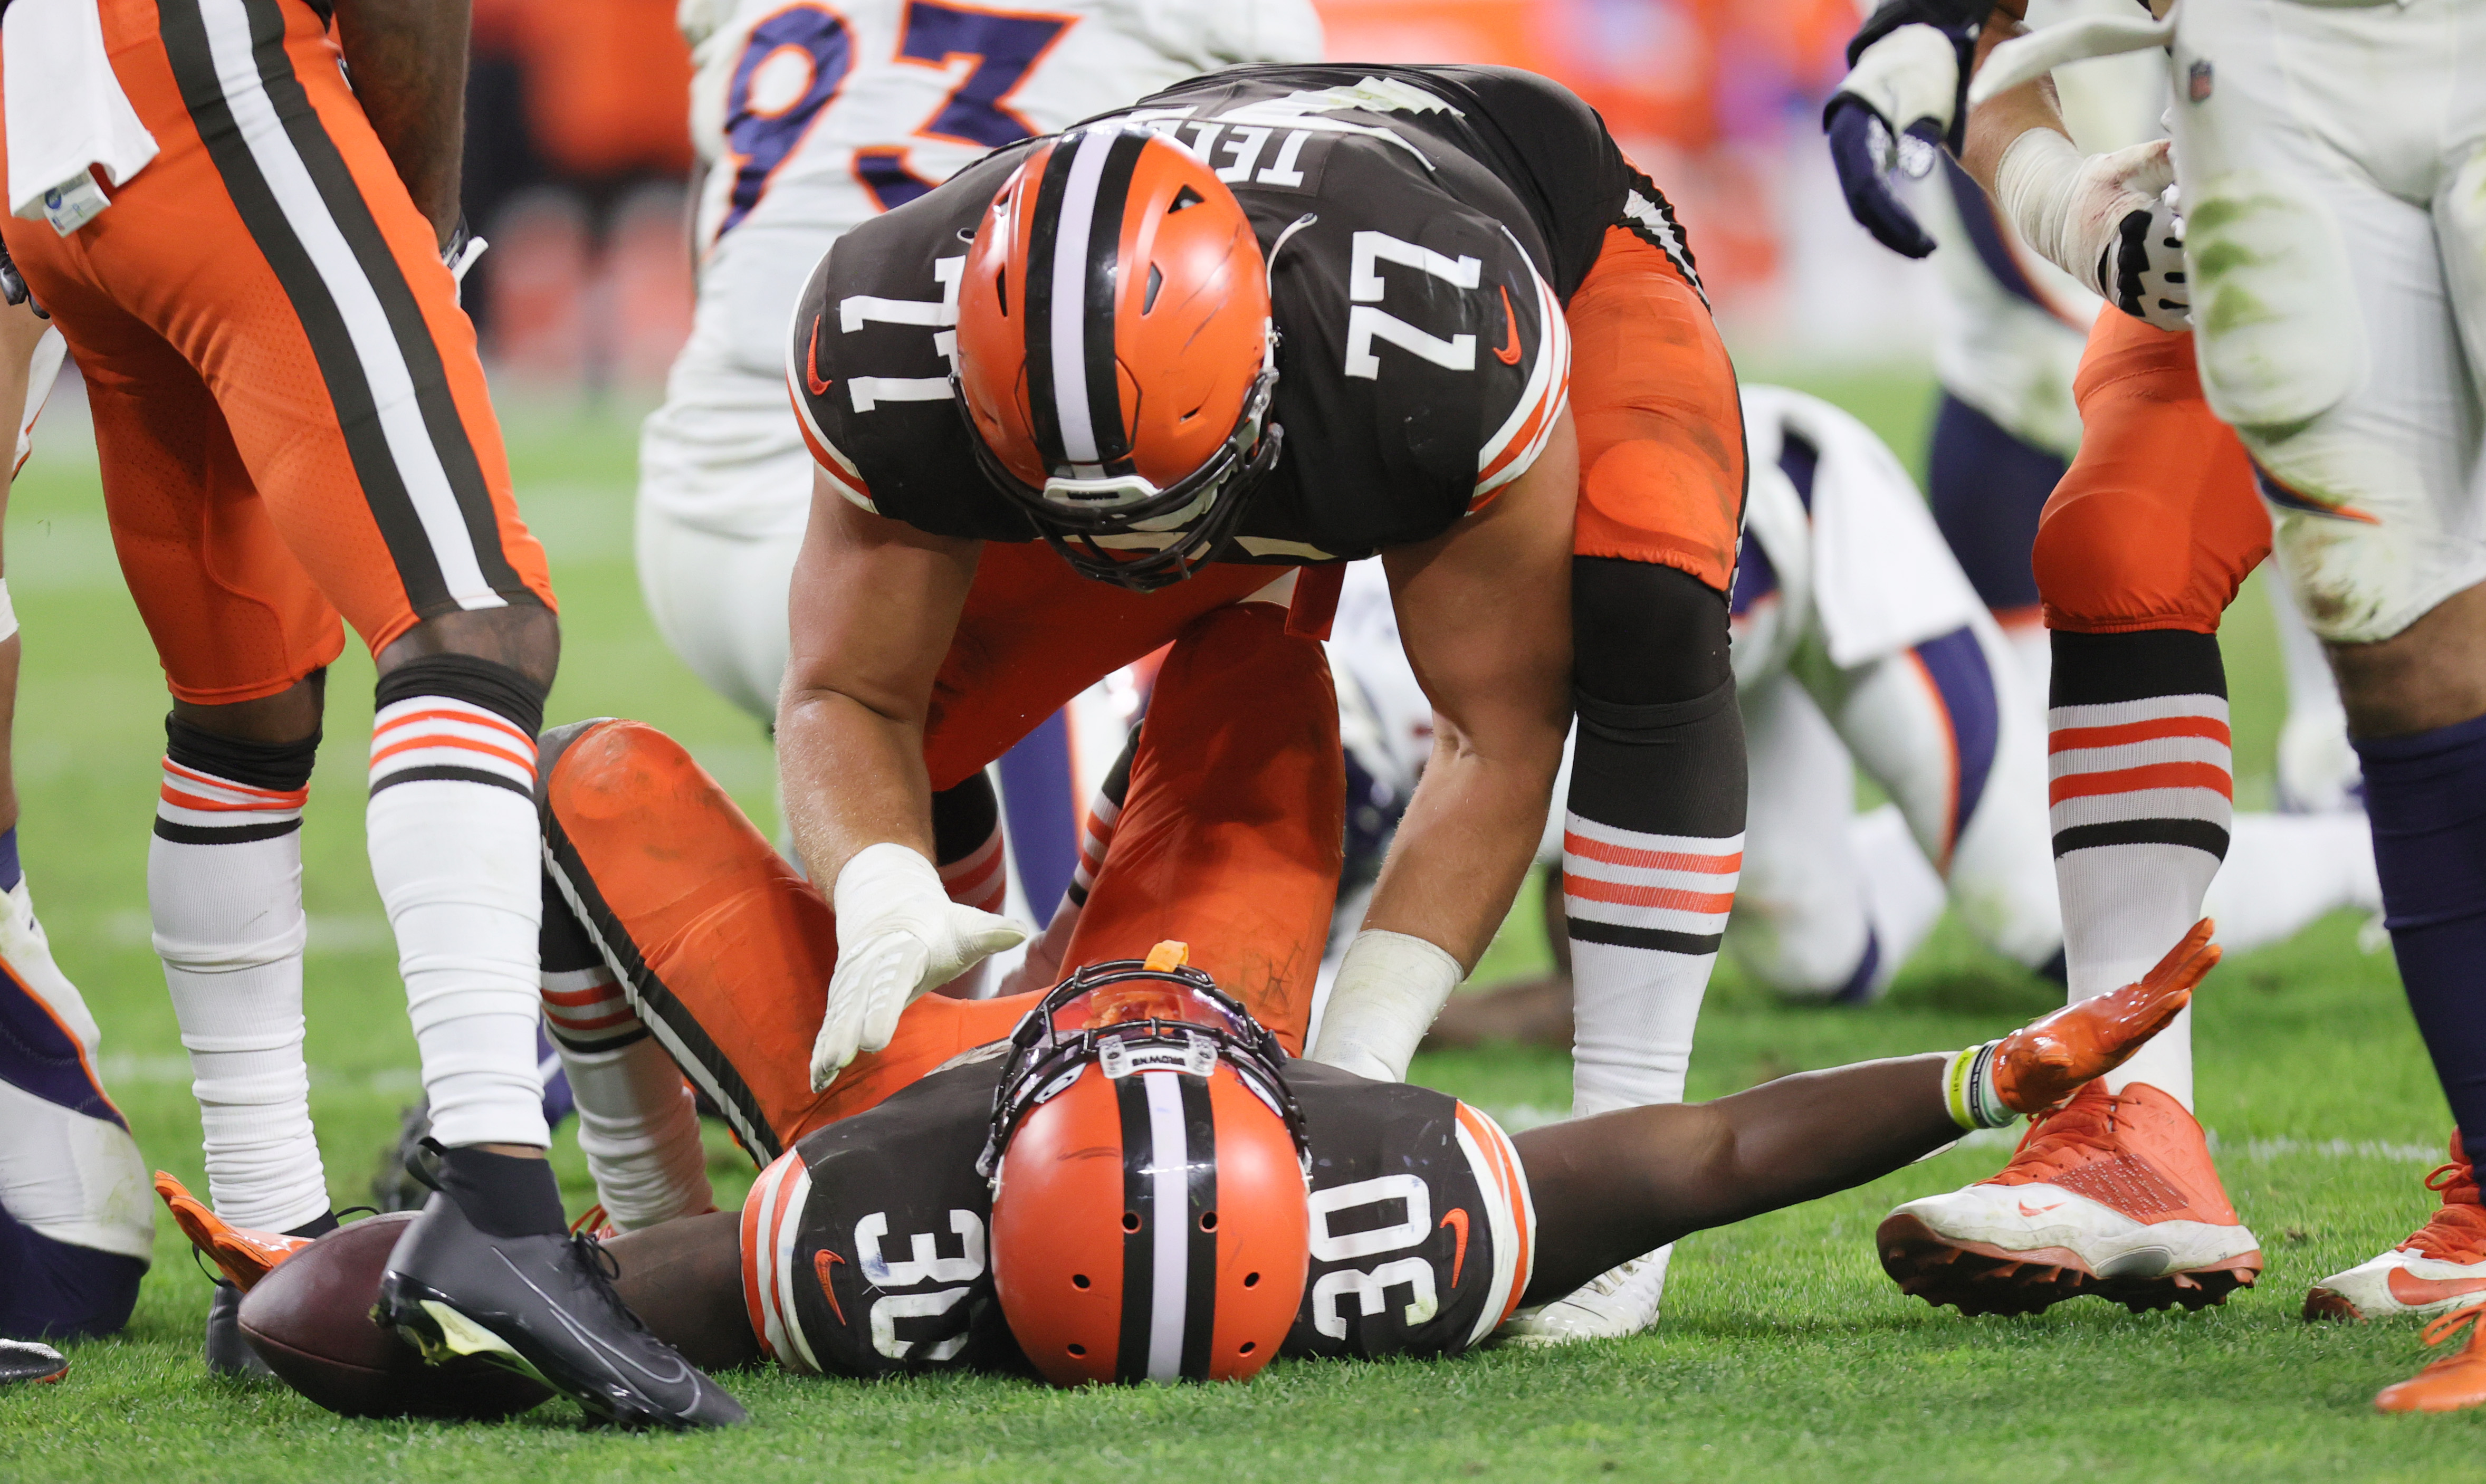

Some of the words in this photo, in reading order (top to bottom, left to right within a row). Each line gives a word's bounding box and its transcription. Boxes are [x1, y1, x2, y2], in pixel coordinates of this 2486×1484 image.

[704, 1, 1081, 254] 93
[1344, 231, 1482, 380] 77
[854, 1209, 986, 1361] 30
[1306, 1174, 1438, 1340] 30
